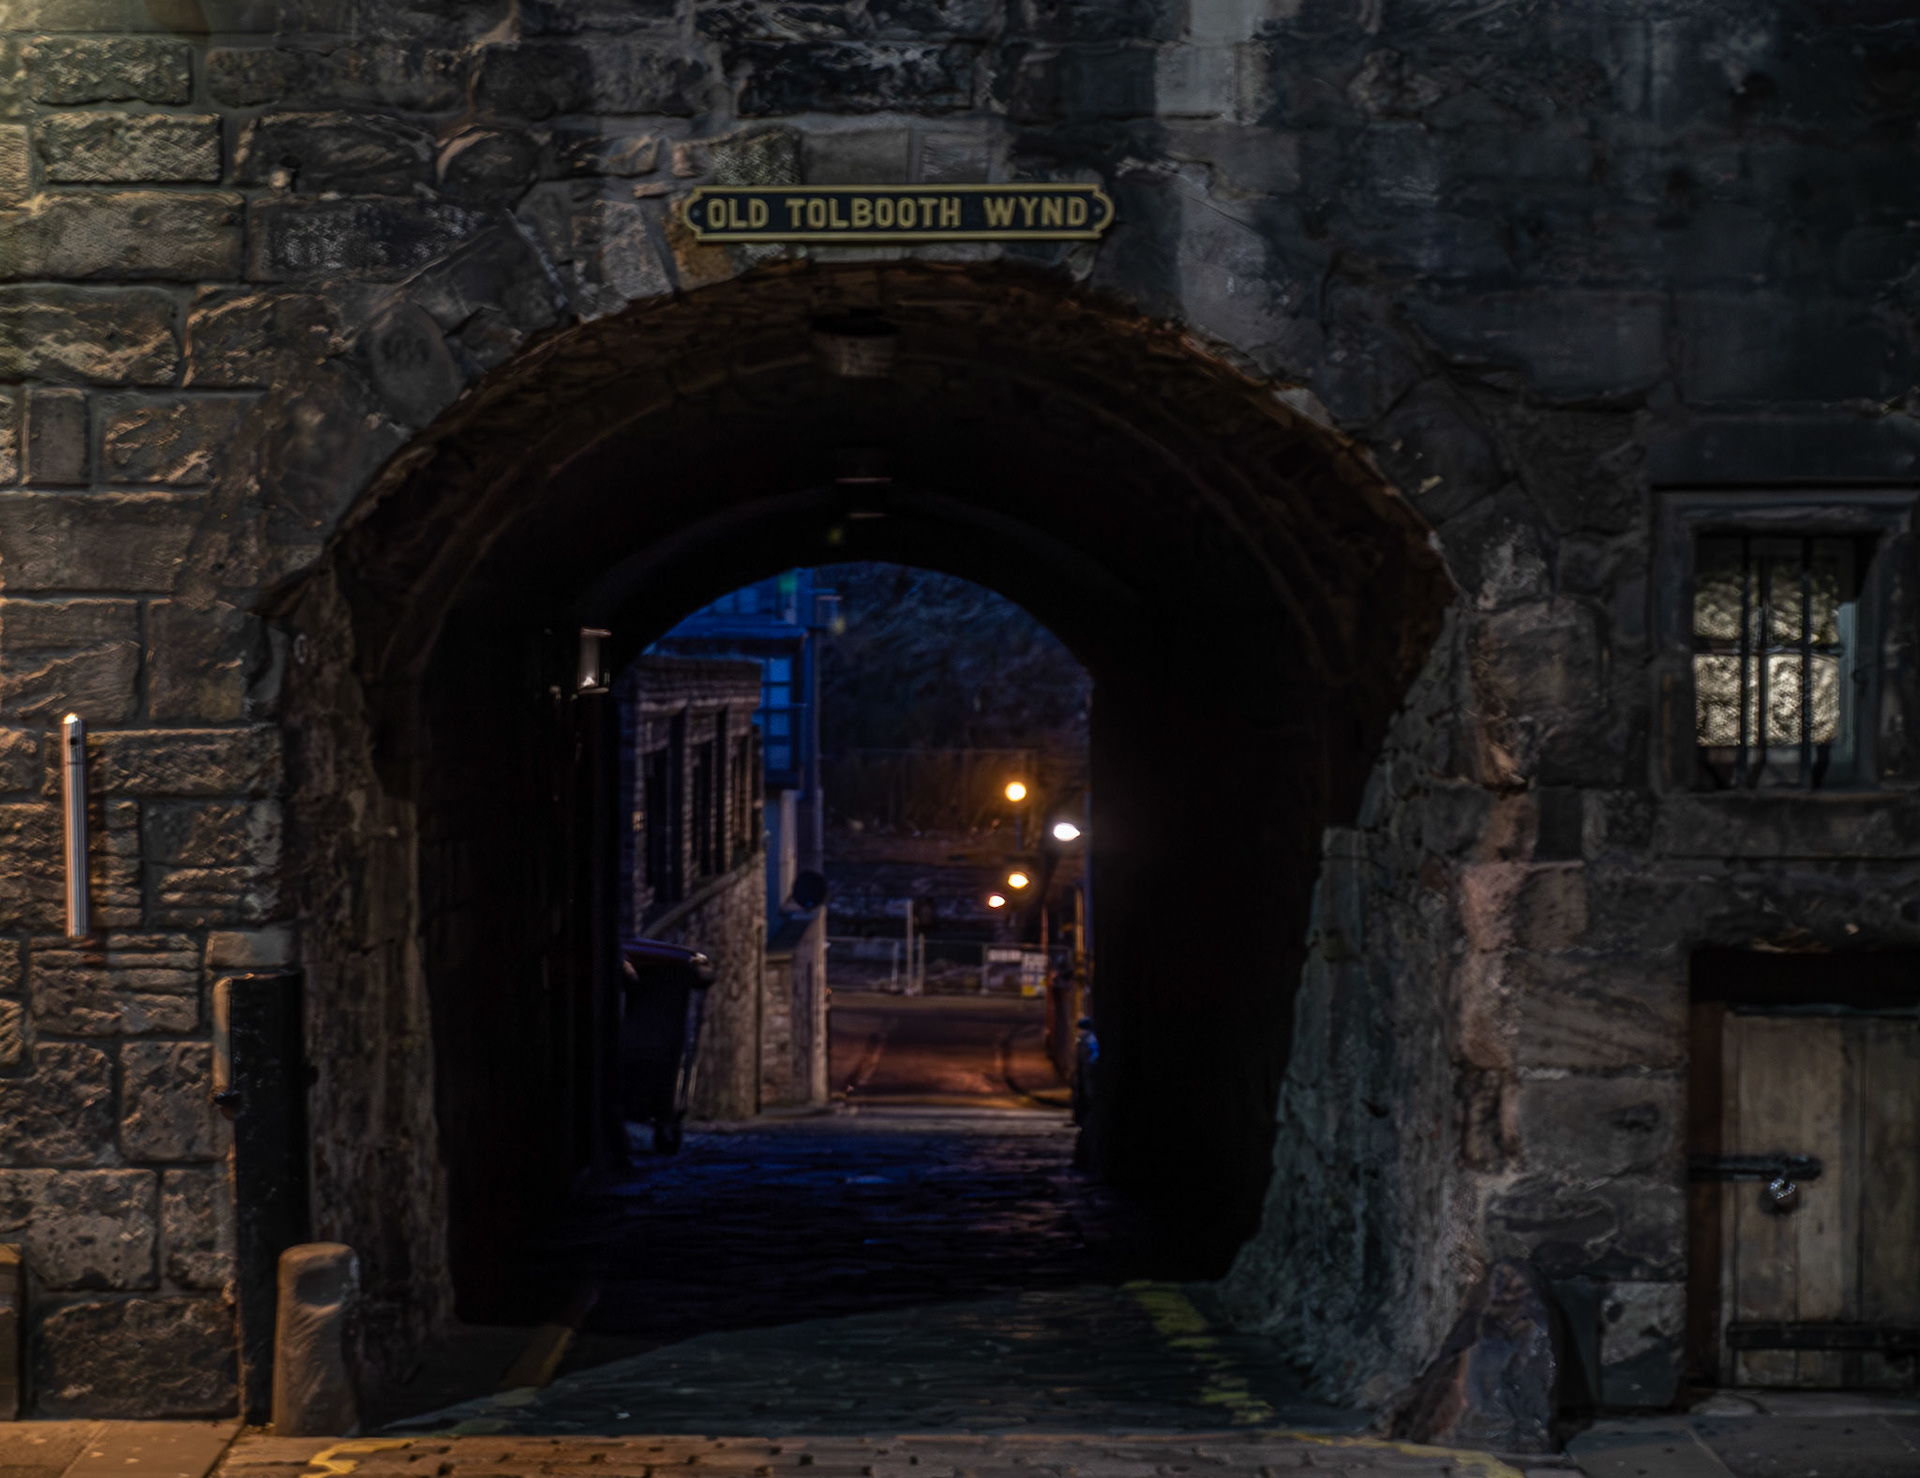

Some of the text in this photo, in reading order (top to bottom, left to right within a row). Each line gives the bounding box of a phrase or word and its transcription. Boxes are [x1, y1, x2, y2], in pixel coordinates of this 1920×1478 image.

[706, 196, 1089, 230] OLD TOLBOOTH WYND
